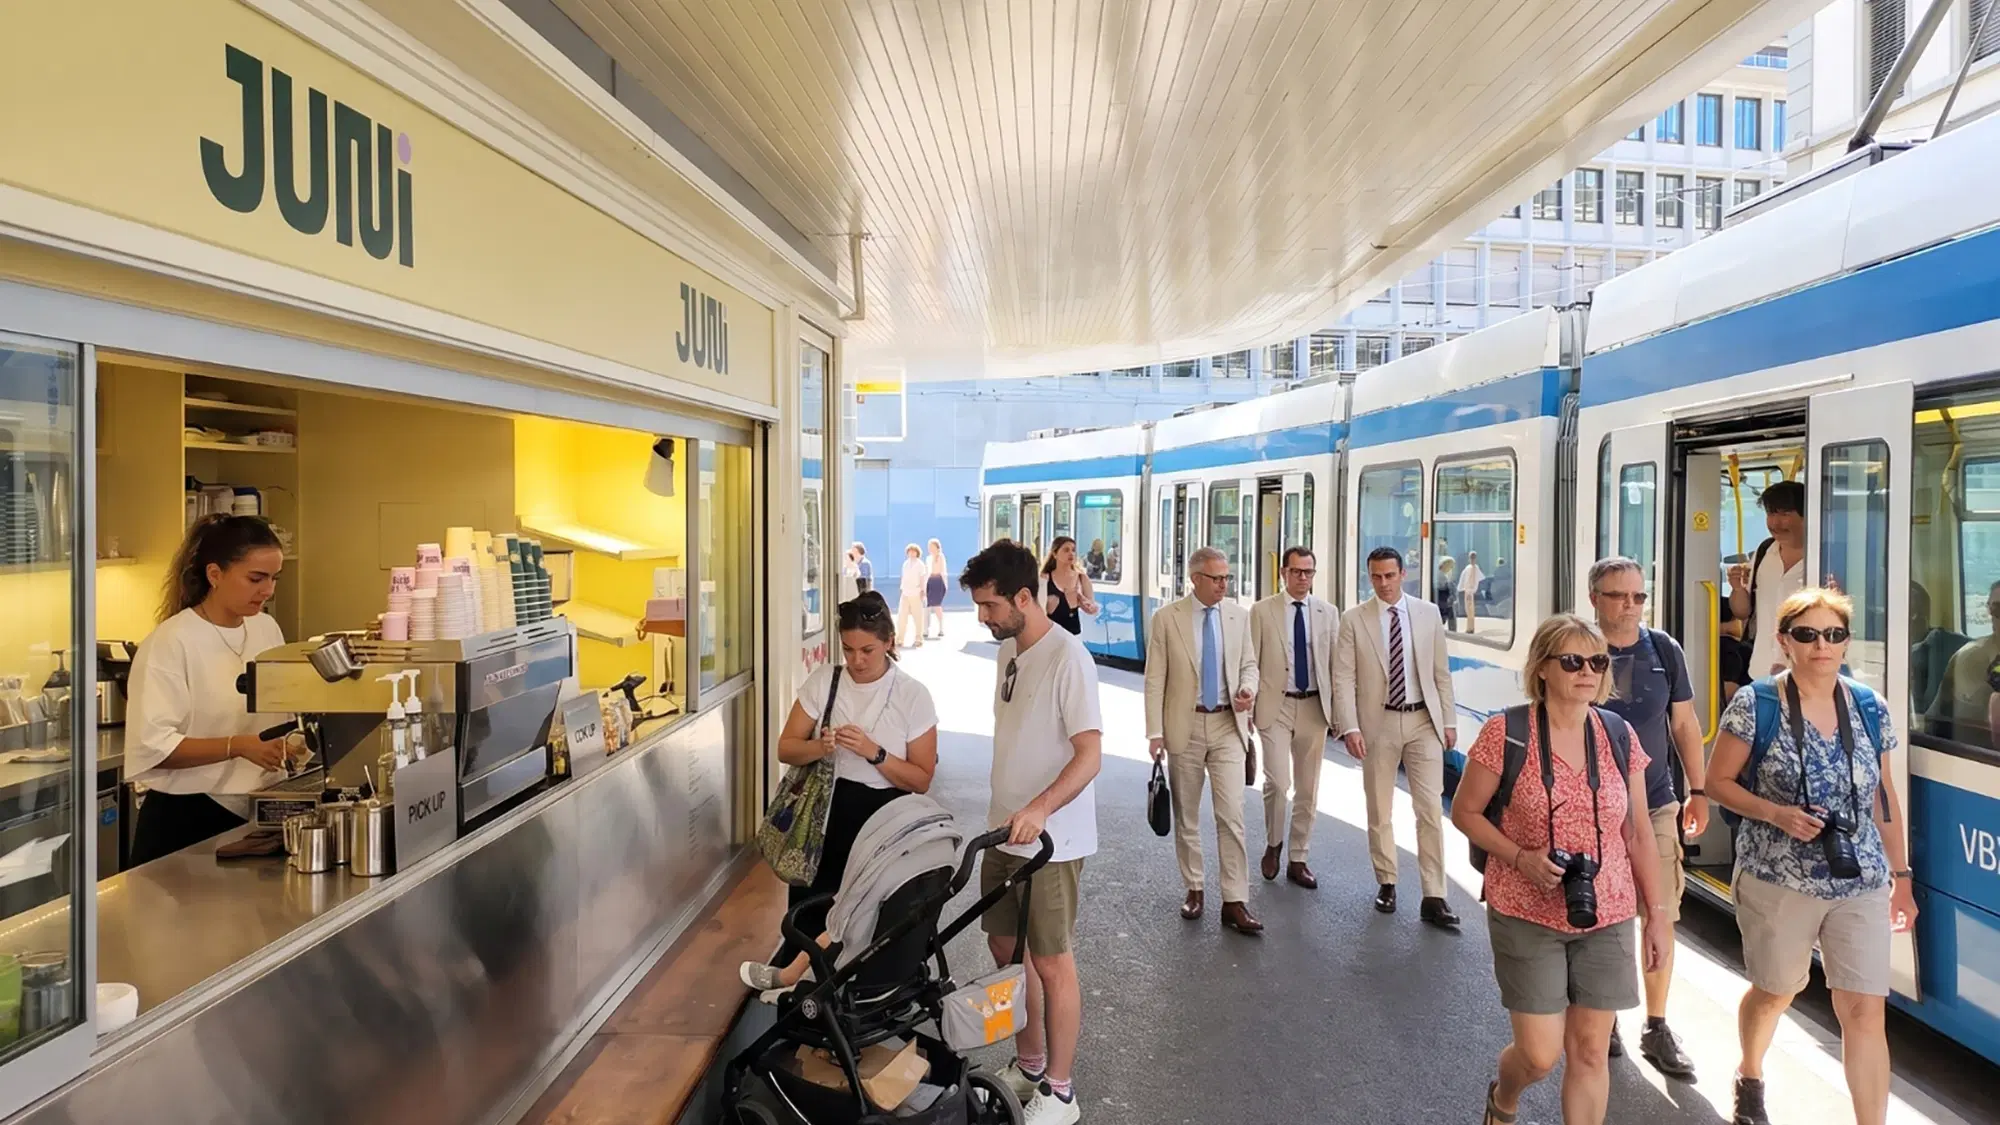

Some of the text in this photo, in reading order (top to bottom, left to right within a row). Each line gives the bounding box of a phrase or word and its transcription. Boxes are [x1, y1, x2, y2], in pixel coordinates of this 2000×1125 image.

[408, 790, 446, 824] PICK UP
[1959, 823, 2000, 875] VB
